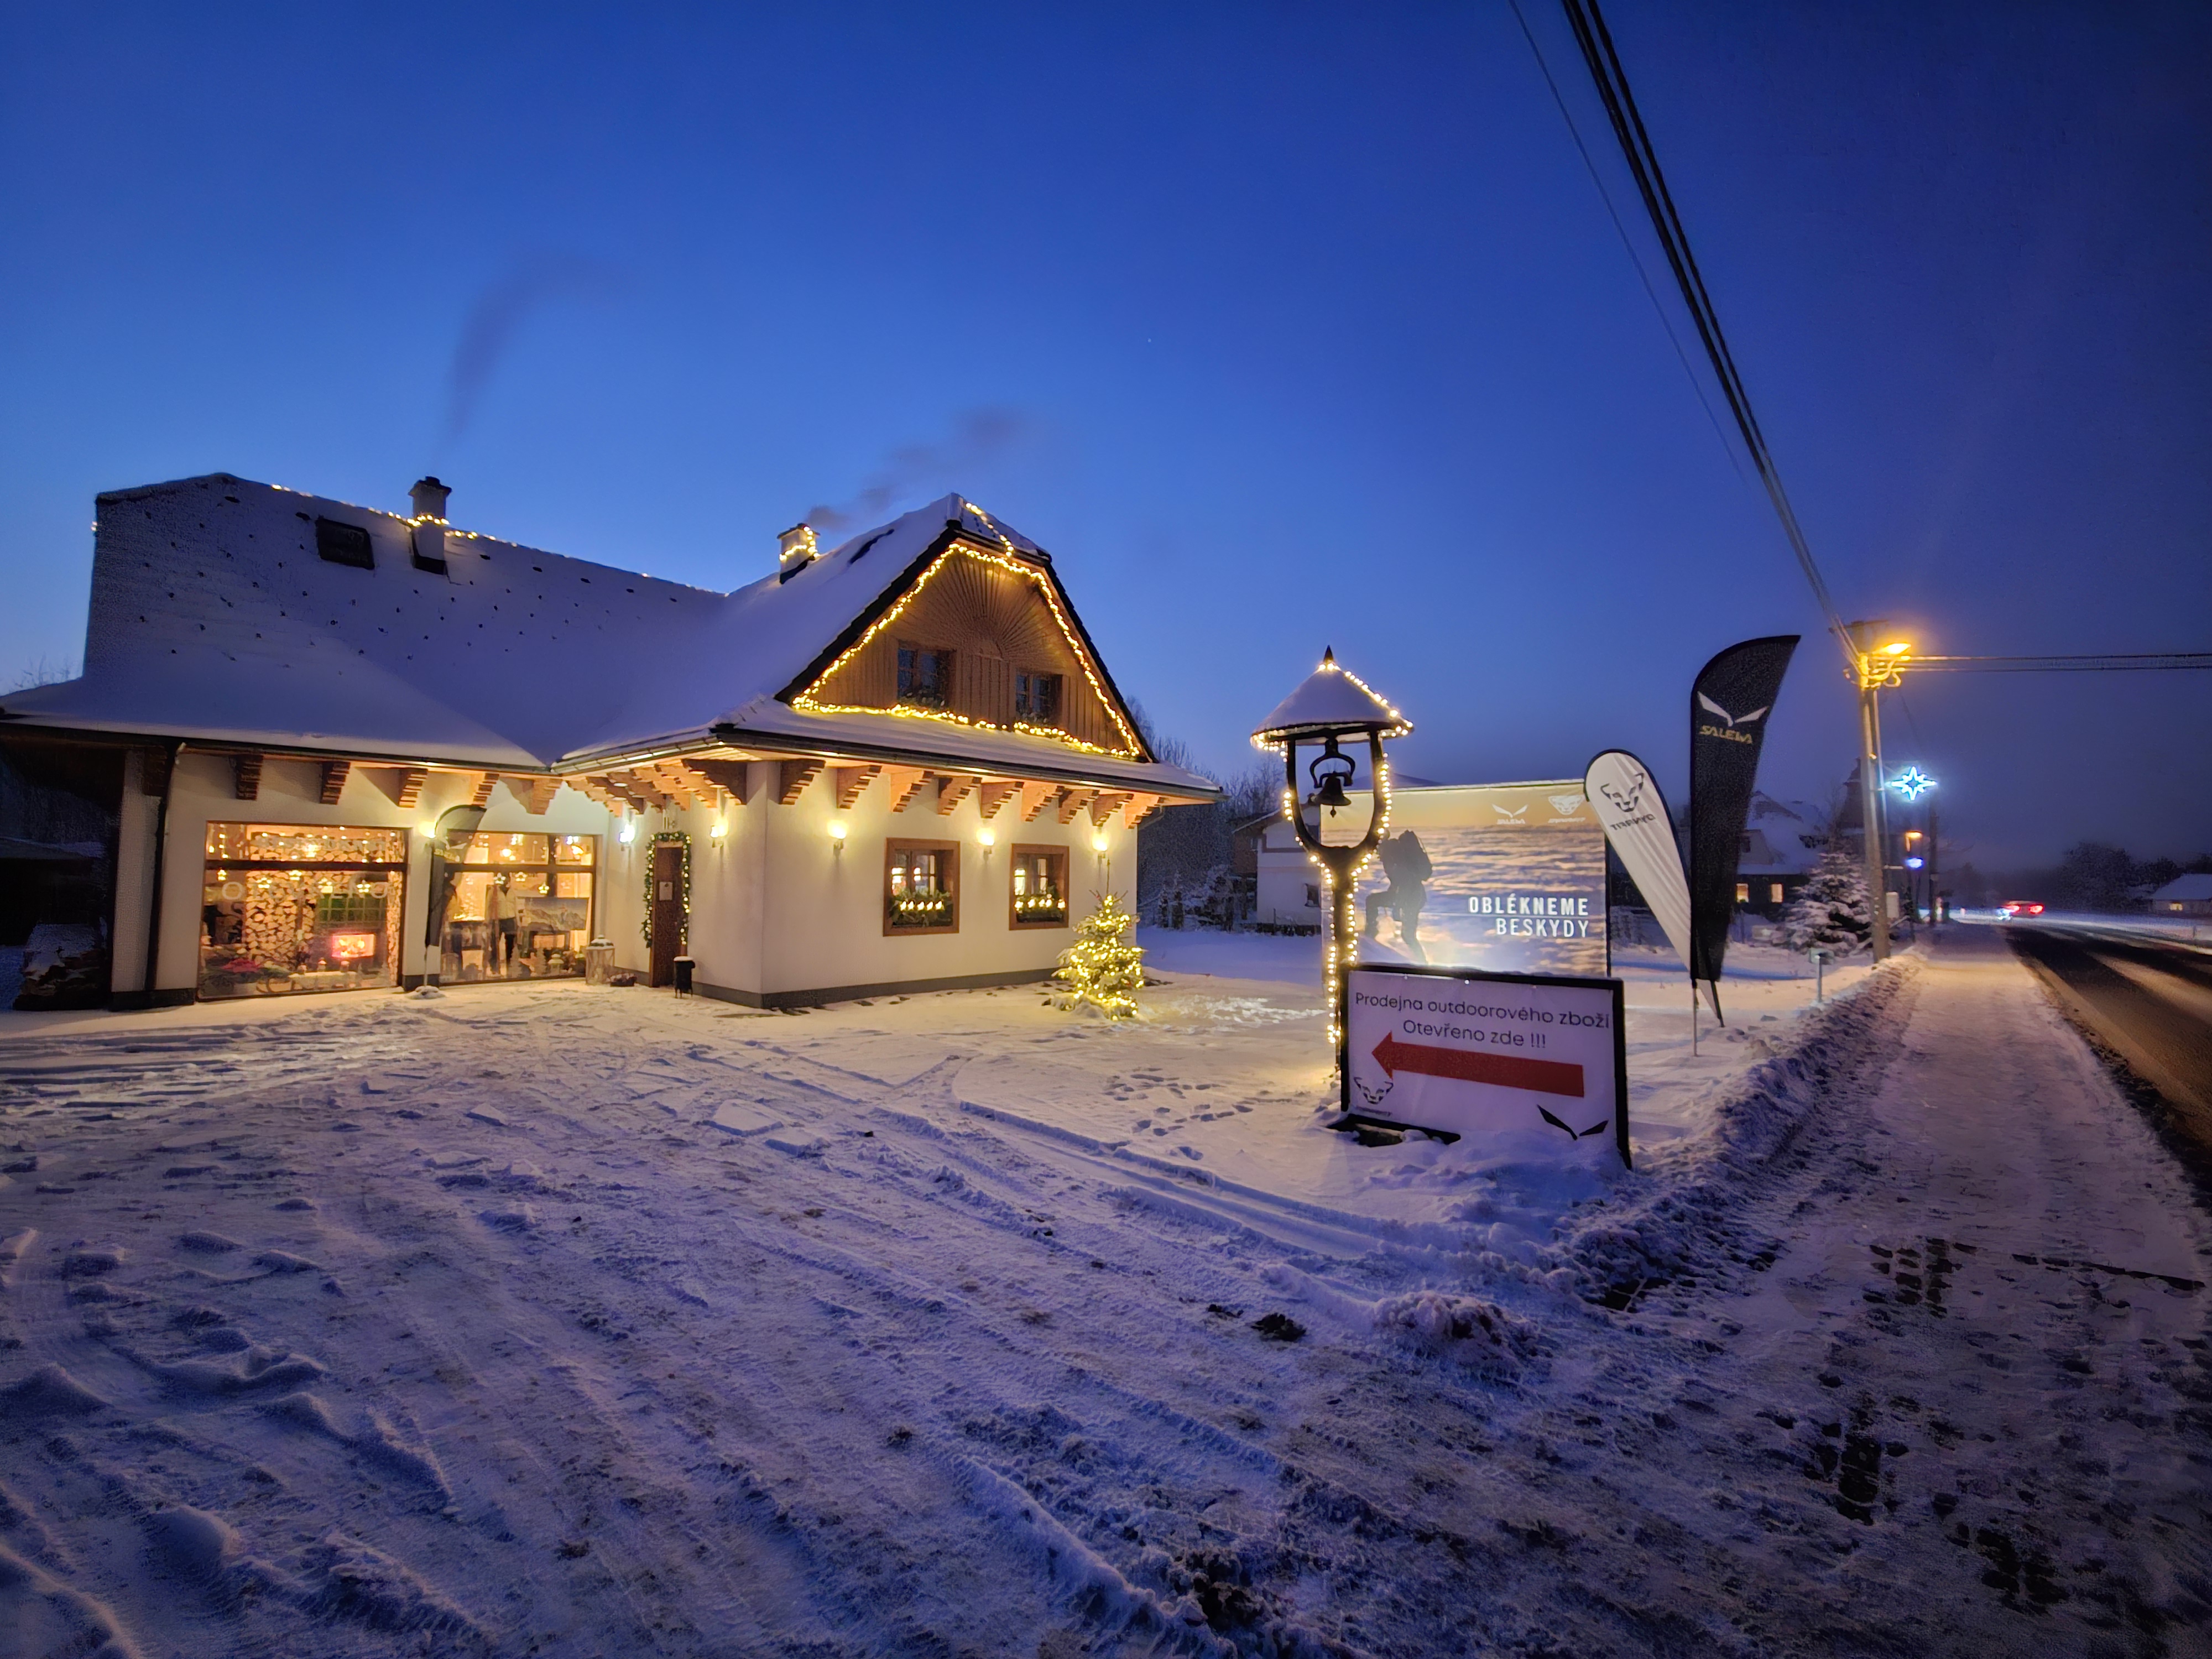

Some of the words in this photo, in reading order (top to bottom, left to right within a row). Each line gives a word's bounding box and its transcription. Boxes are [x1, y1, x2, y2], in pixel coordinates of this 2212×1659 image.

[1699, 725, 1753, 744] SALEWA
[1468, 893, 1589, 916] OBLÉKNEME
[1495, 918, 1589, 938] BESKYDY
[1355, 992, 1423, 1012] Prodejna
[1428, 1000, 1554, 1024] outdoorového
[1559, 1011, 1610, 1029] zboží
[1402, 1019, 1485, 1042] Otevřeno
[1490, 1031, 1525, 1046] zde
[1531, 1033, 1546, 1048] !!!
